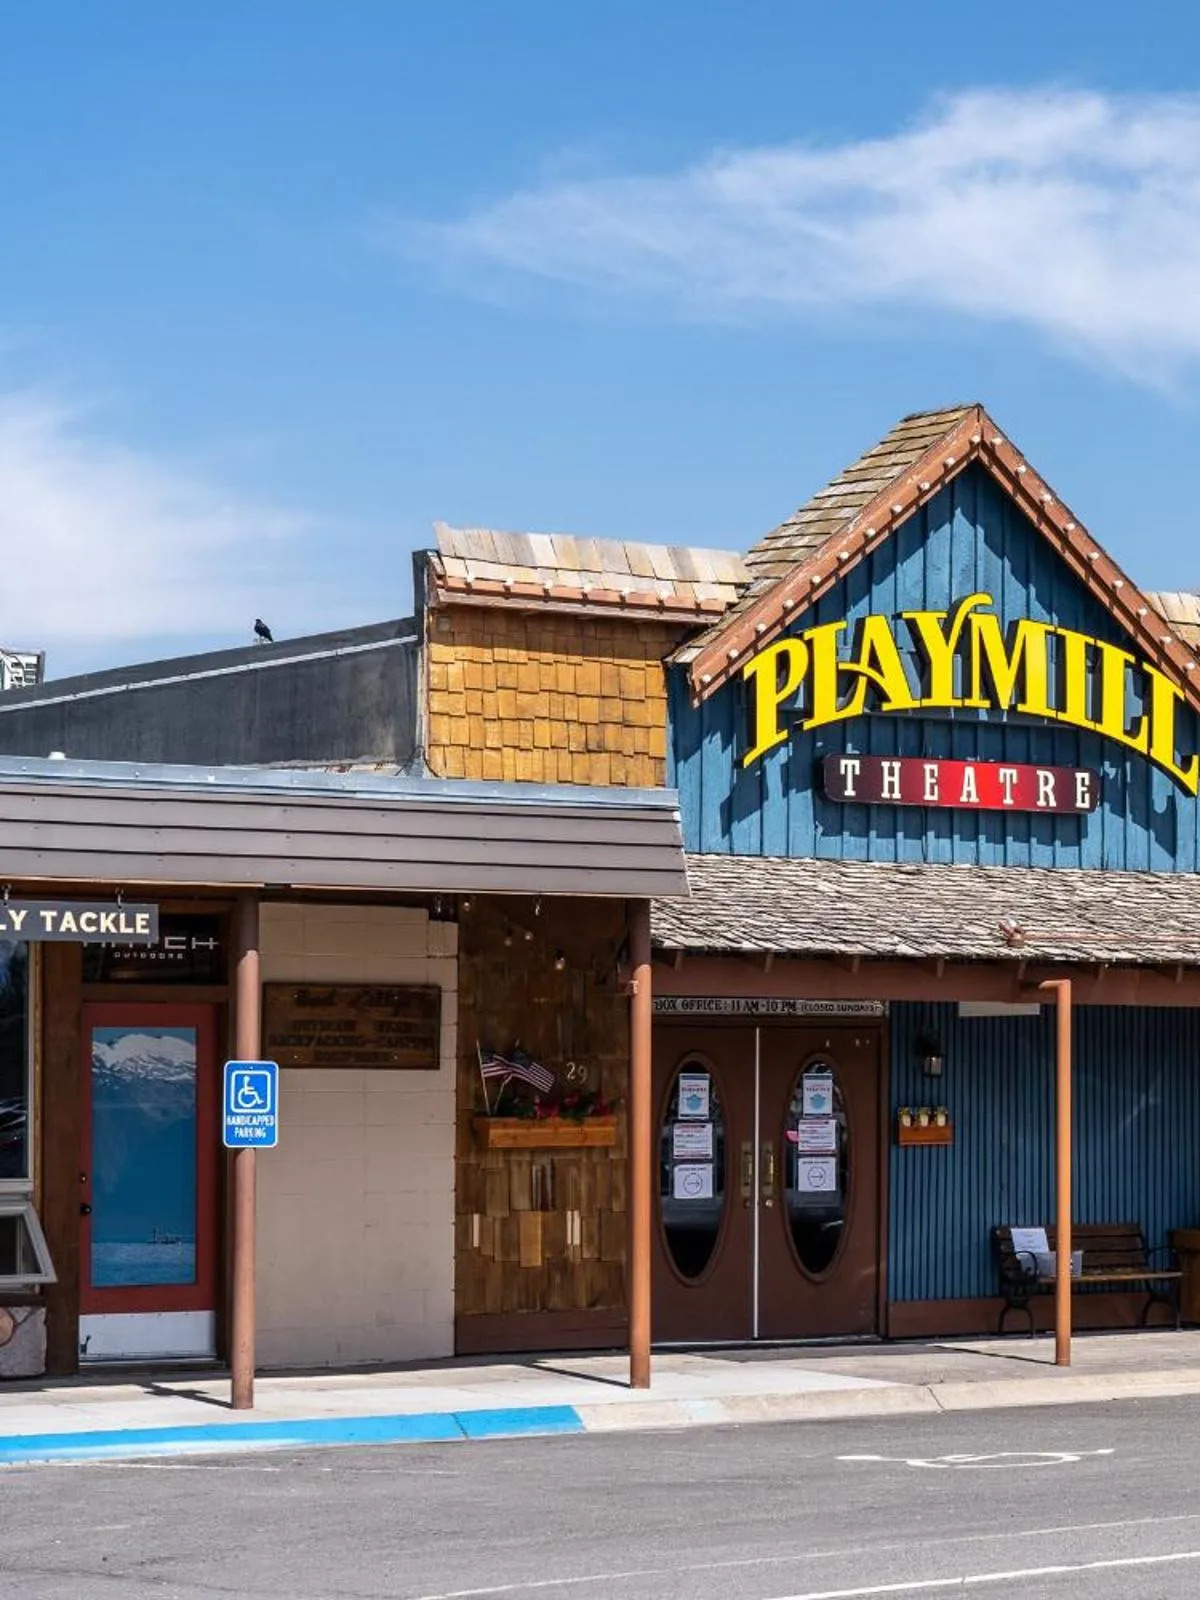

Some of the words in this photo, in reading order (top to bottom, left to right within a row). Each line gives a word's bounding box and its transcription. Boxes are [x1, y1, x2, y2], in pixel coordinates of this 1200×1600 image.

[742, 592, 1199, 797] PLAYMILL
[840, 758, 1091, 809] THEATRE
[39, 910, 151, 935] TACKLE
[655, 999, 677, 1010] BOX
[566, 1061, 588, 1085] 29
[226, 1115, 275, 1127] HANDICAPPED
[234, 1127, 267, 1139] PARKING
